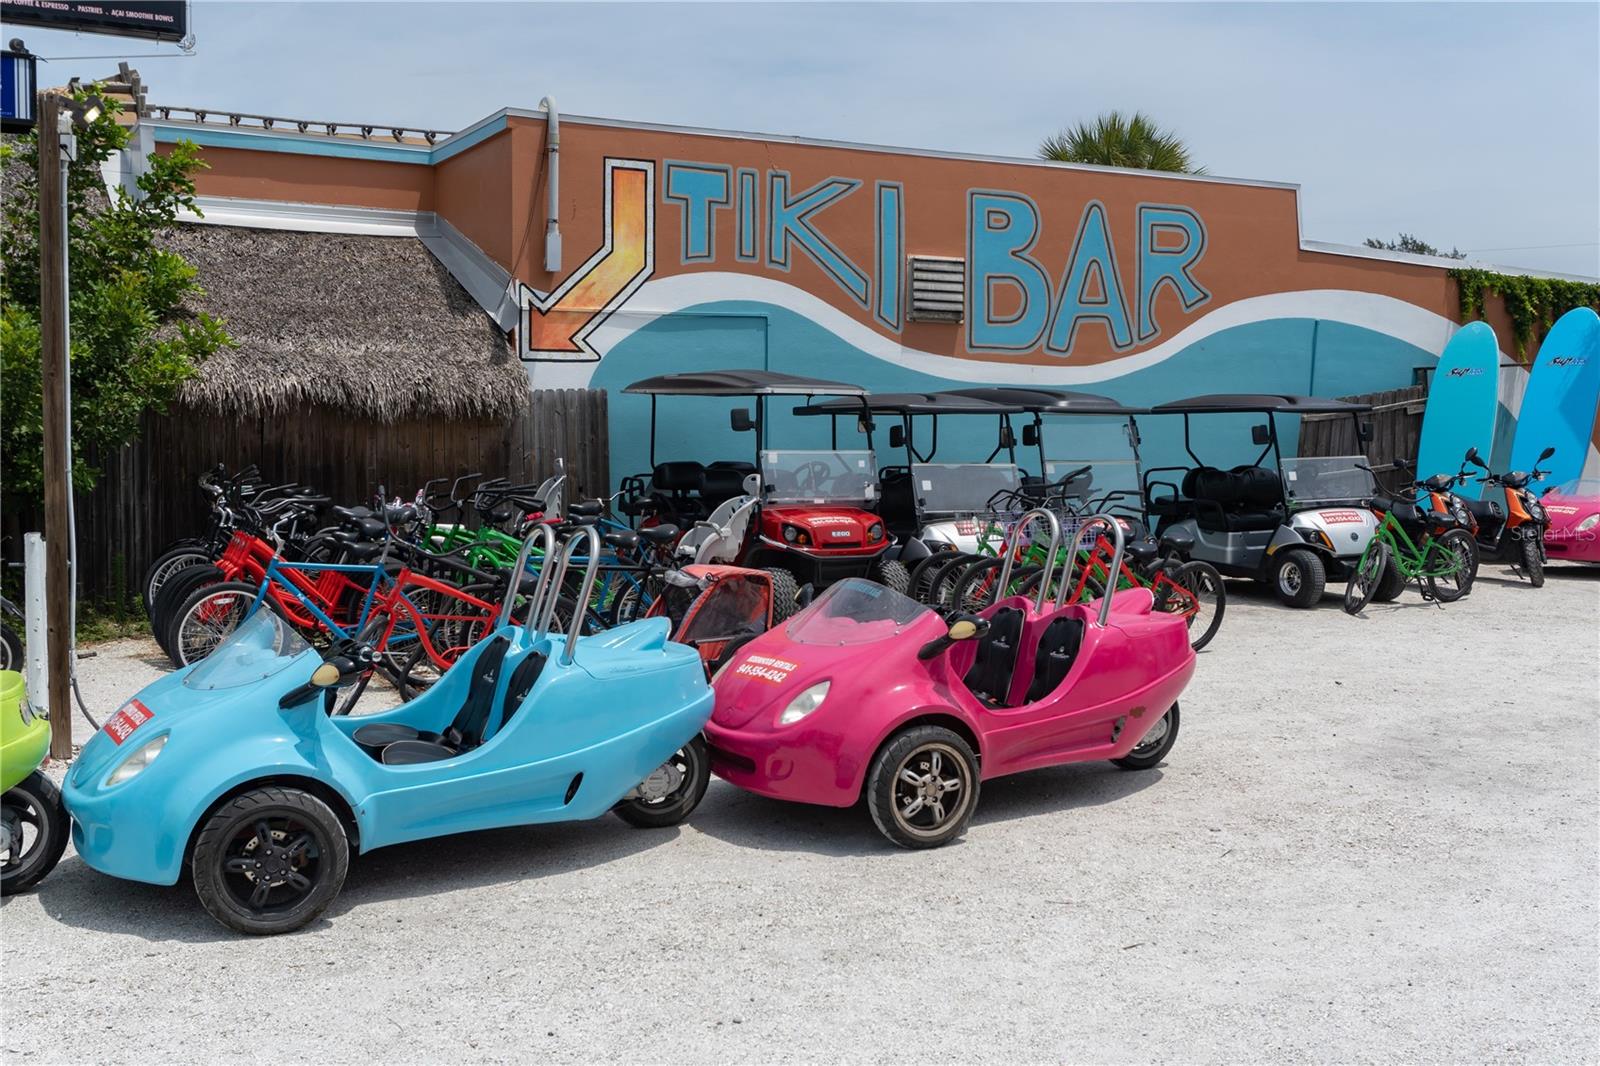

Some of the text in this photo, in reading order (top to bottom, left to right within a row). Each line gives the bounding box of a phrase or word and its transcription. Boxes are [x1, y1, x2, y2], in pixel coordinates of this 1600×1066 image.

[41, 1, 70, 11] ESPRESSO
[77, 5, 103, 15] PASTRIES
[126, 10, 154, 20] SMOOTHIE
[155, 14, 174, 22] BOWLS
[663, 159, 1212, 357] TIKI BAR
[736, 663, 788, 683] 941-554-4242
